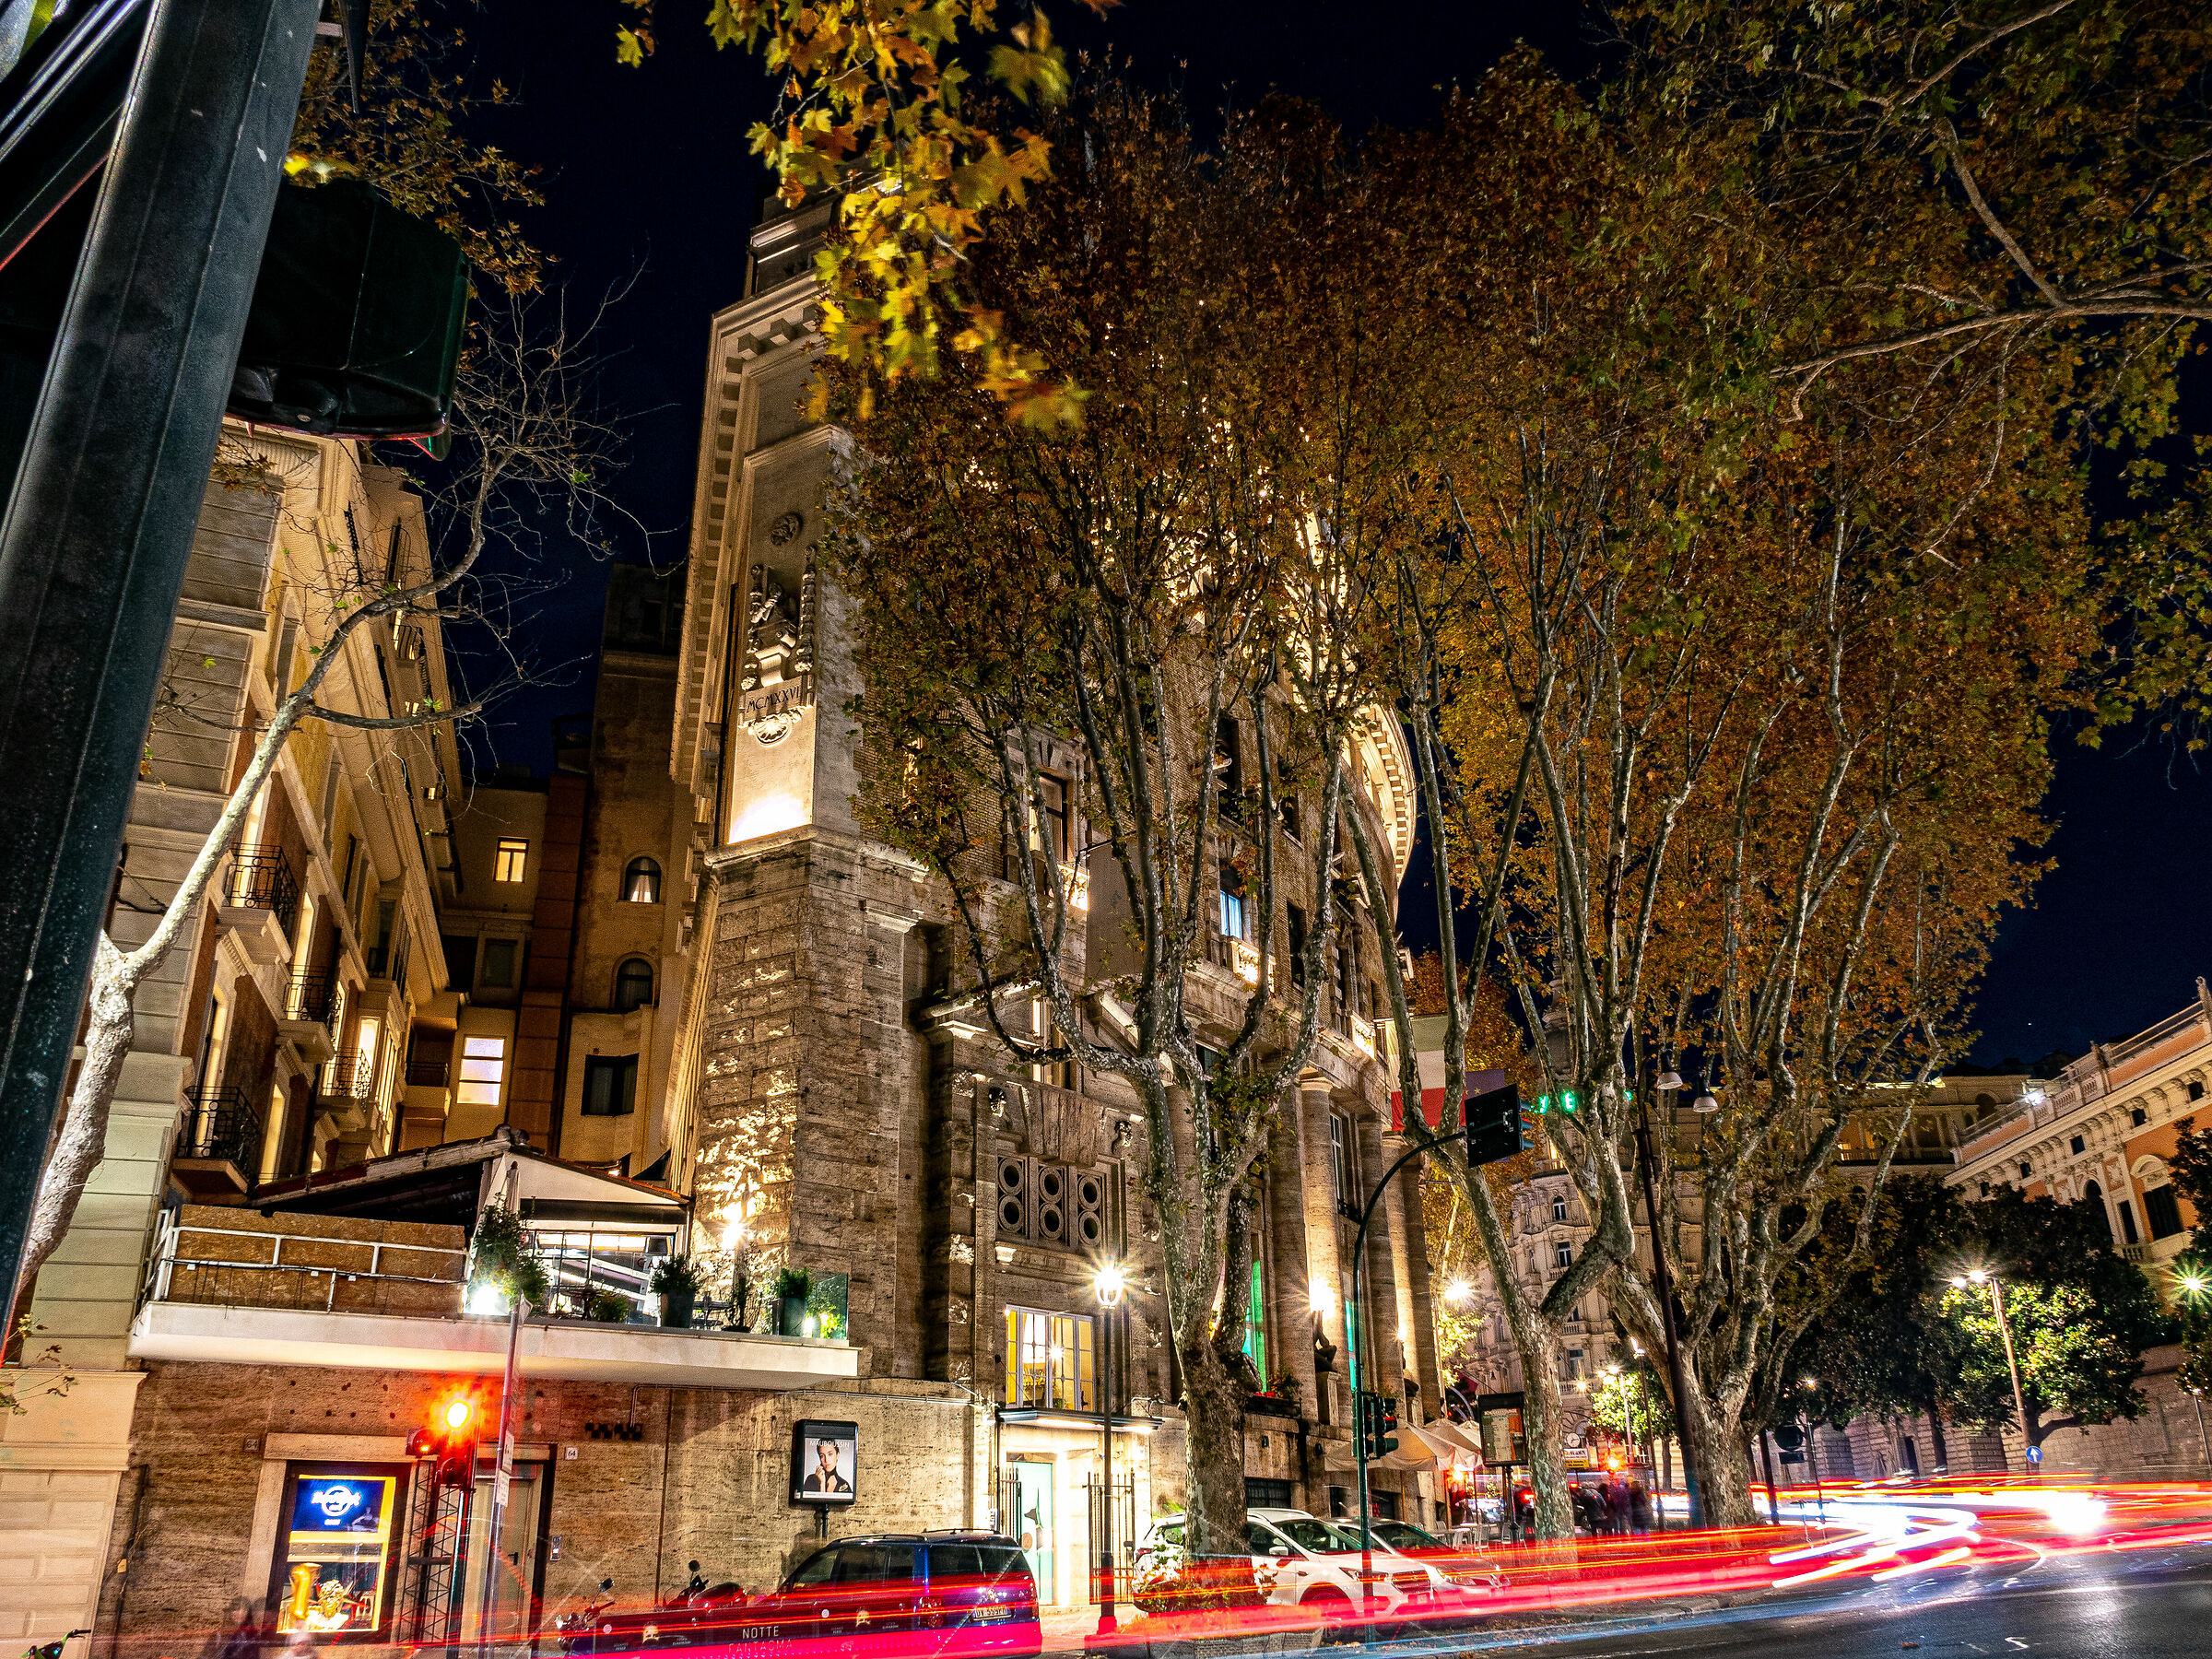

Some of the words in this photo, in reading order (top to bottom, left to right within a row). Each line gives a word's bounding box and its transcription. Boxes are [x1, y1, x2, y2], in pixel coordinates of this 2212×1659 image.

[746, 686, 800, 713] MCMXXVI
[809, 1440, 850, 1448] MAUBOUSSIN
[742, 1626, 780, 1640] NOTTE
